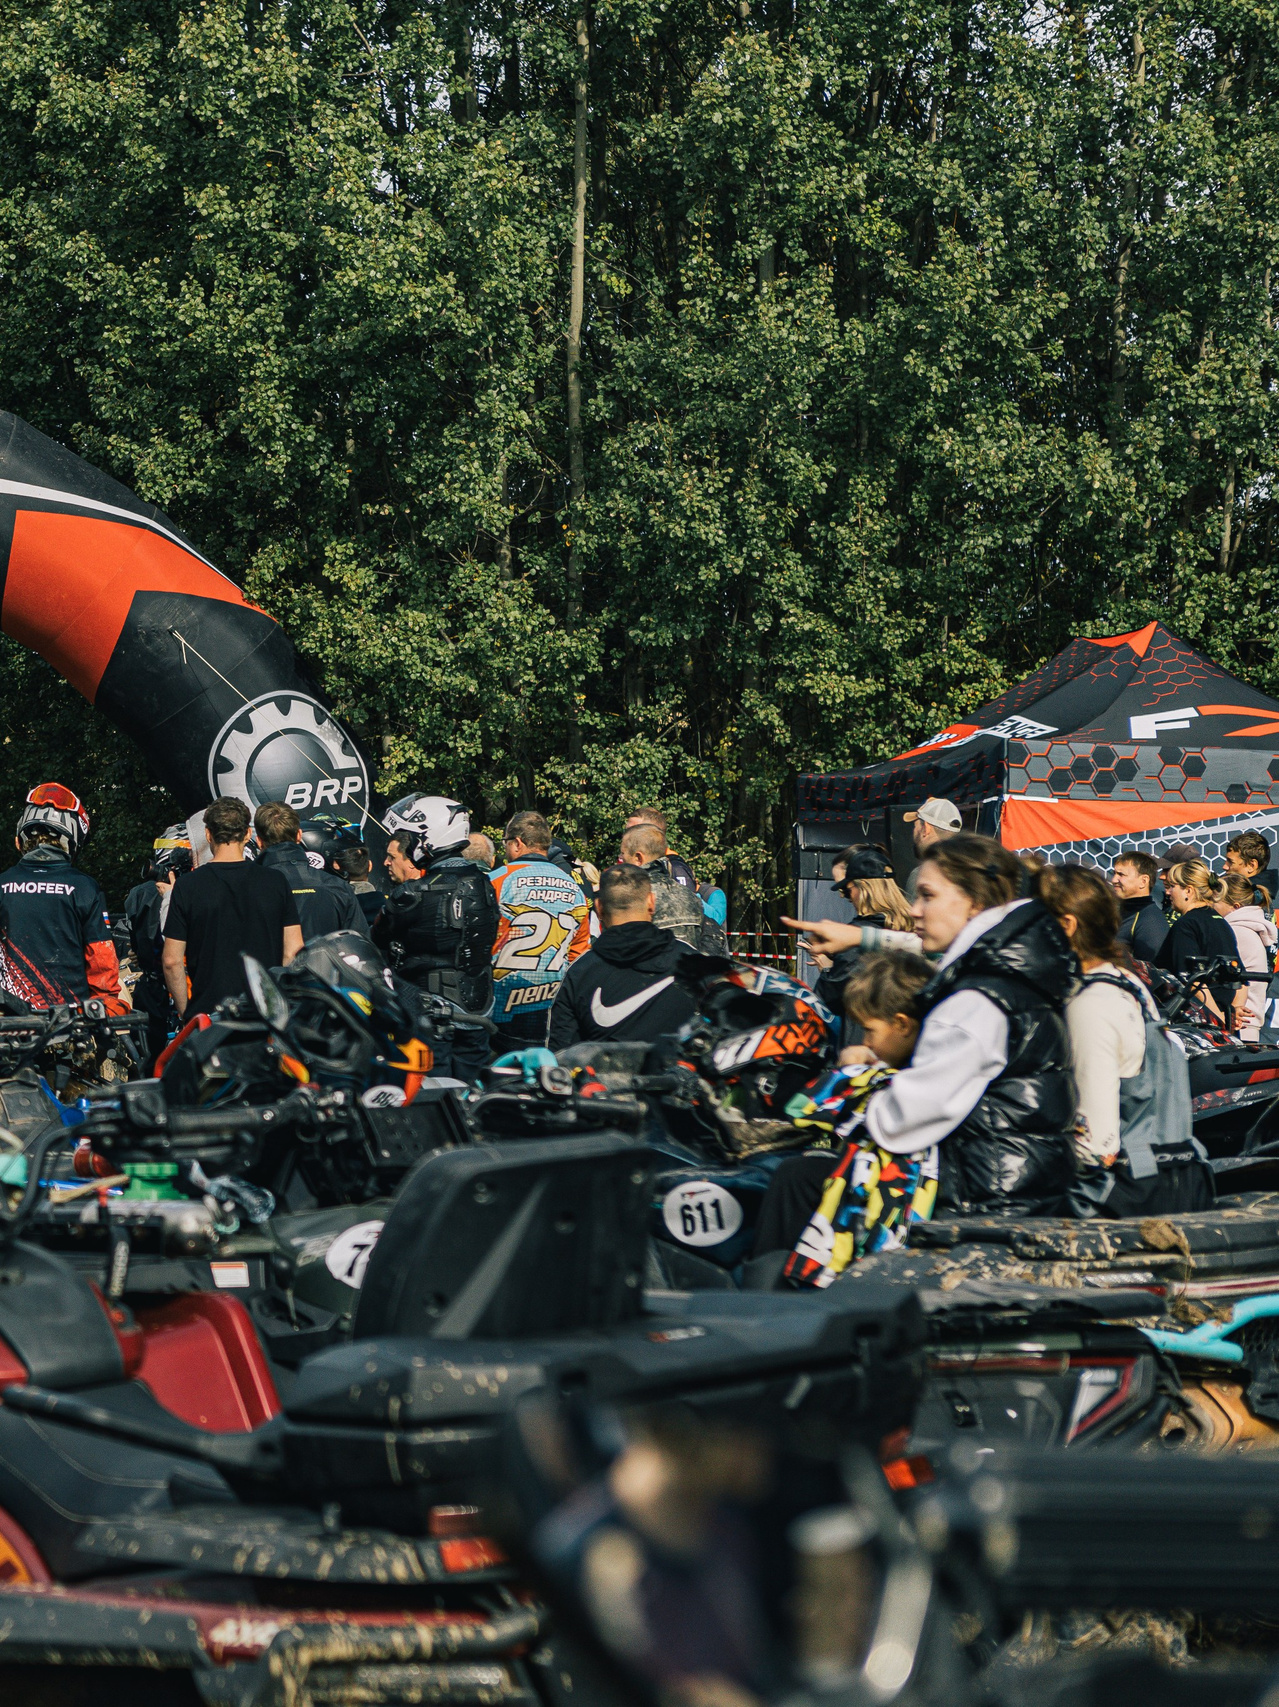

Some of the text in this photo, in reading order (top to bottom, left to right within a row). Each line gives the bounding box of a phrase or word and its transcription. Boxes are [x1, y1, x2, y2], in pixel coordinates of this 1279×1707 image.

[284, 775, 363, 810] BRP
[1, 882, 75, 895] TIMOFEEV
[526, 890, 576, 904] АНДРЕЙ
[680, 1198, 726, 1237] 611
